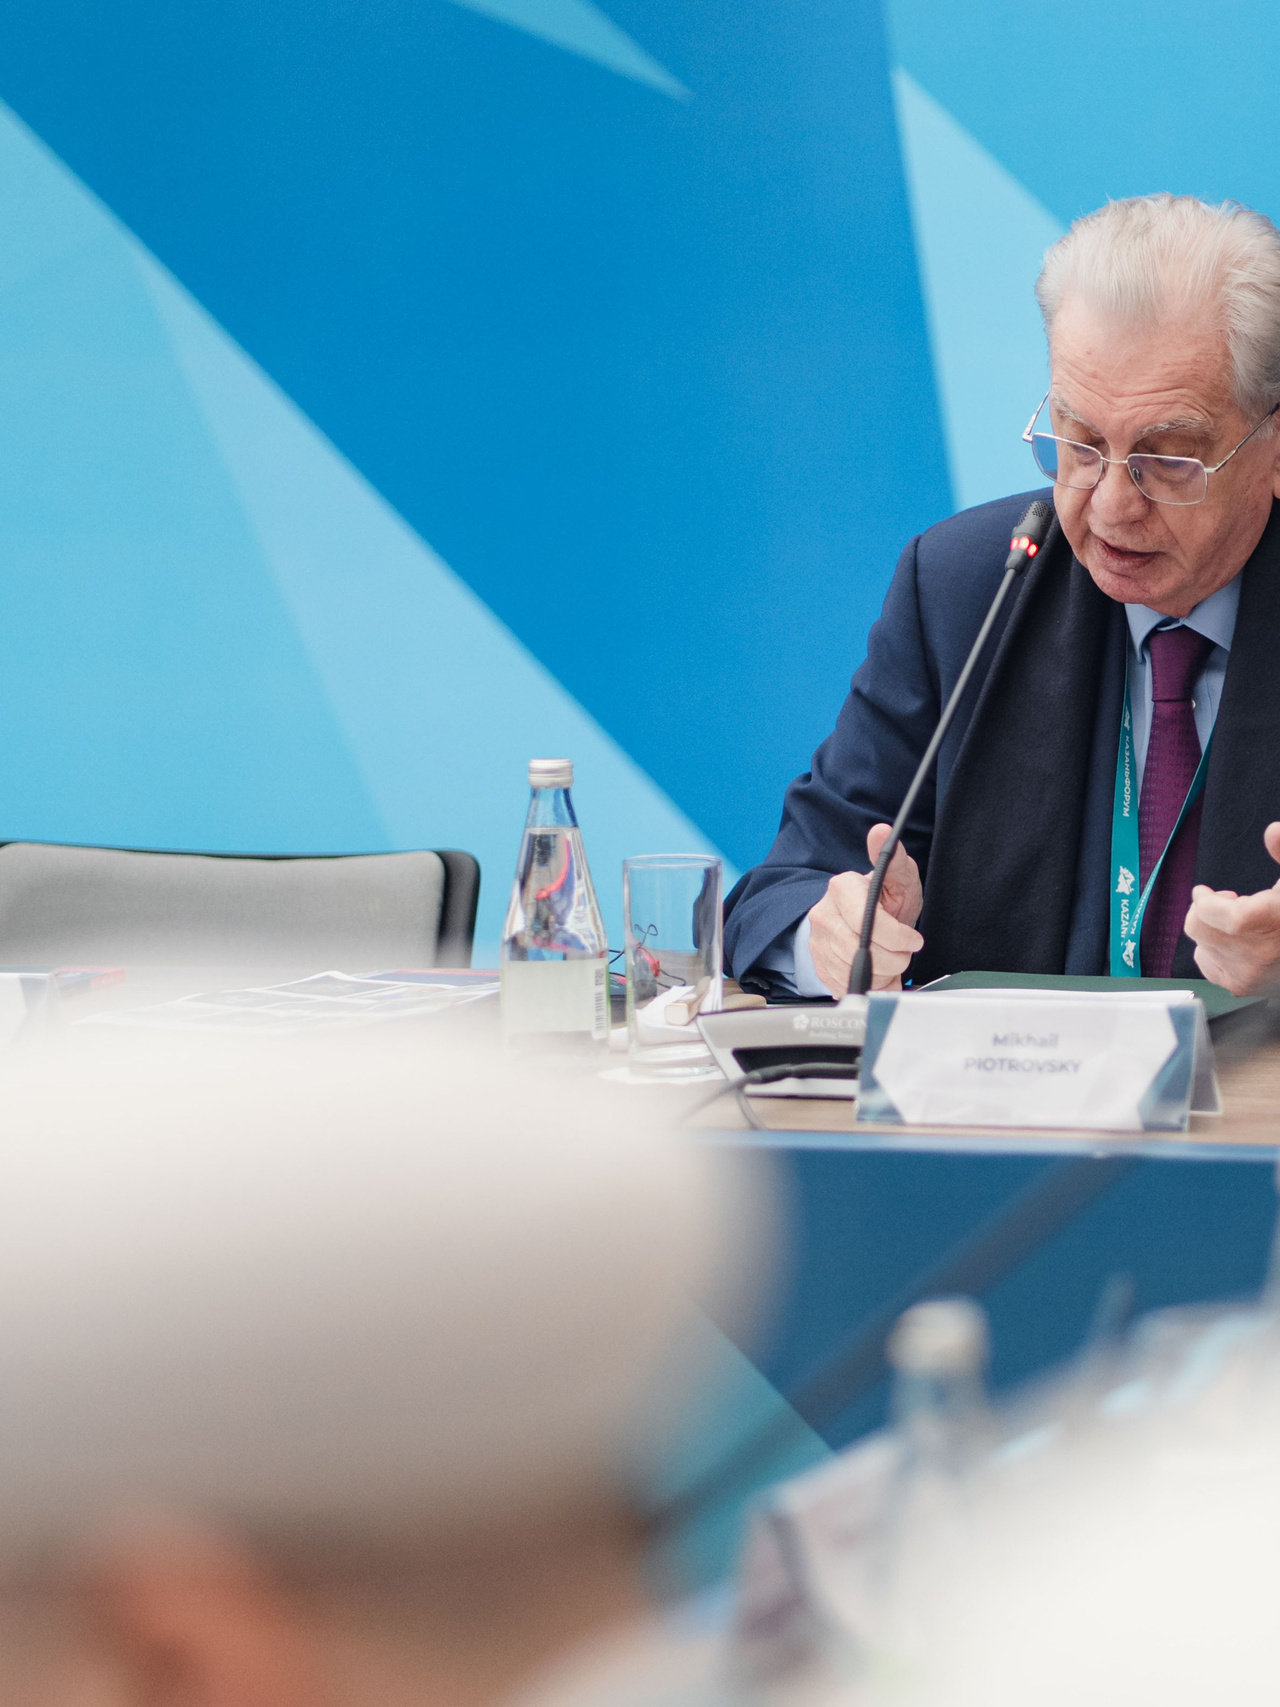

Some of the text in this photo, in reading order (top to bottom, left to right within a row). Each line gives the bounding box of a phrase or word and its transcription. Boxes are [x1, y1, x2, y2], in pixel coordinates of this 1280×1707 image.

[1121, 899, 1130, 946] KAZAN
[992, 1033, 1059, 1047] Mikhail
[963, 1057, 1081, 1073] PIOTROVSKY
